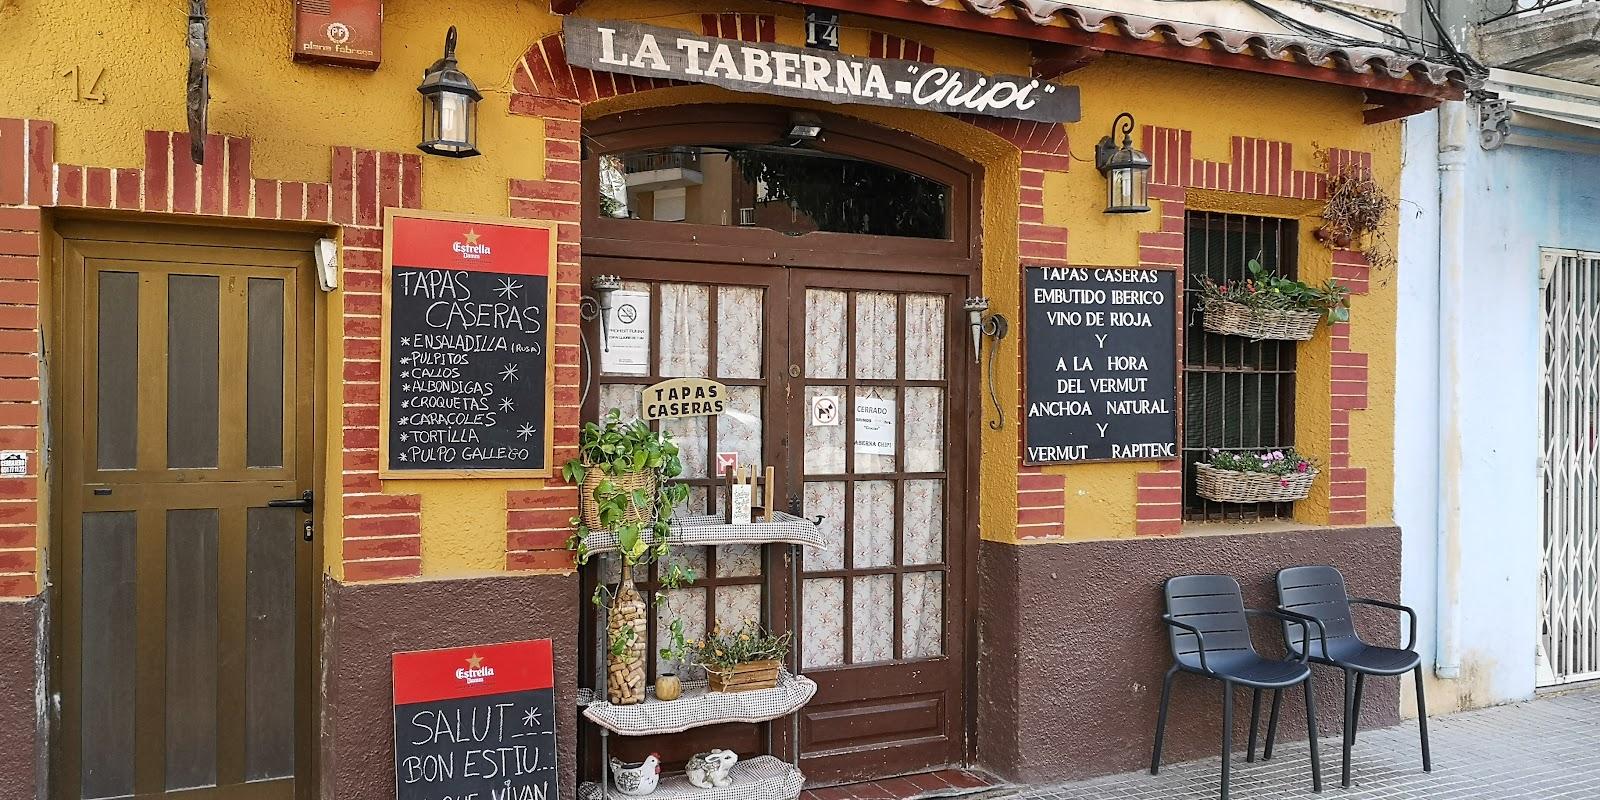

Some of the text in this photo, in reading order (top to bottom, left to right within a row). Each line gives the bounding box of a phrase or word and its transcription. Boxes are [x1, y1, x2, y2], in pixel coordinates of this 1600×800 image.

[807, 12, 838, 48] 14
[597, 27, 671, 71] LA
[62, 64, 107, 105] 14
[452, 240, 491, 255] Estrella
[1040, 266, 1158, 283] TAPAS CASERAS
[398, 269, 471, 301] TAPAS
[1034, 288, 1164, 305] EMBUTIDO IBERICO
[425, 301, 541, 333] CASERAS
[1046, 311, 1152, 327] VINO DE RIOJA
[413, 333, 508, 352] ENSALADILLA
[1095, 334, 1108, 349] Y
[411, 351, 469, 367] PULPITOS
[1055, 356, 1148, 372] A LA HORA
[411, 368, 461, 379] CALLOS
[412, 380, 494, 397] ALBONDIGAS
[655, 385, 718, 401] TAPAS
[1057, 377, 1148, 394] DEL VERMUT
[410, 396, 490, 411] CROQUETAS
[647, 400, 723, 418] CASERAS
[856, 405, 888, 415] CERRADO
[1028, 399, 1169, 417] ANCHOA NATURAL
[409, 412, 497, 427] CARACOLES
[409, 427, 480, 443] TORTILLA
[1096, 422, 1109, 438] Y
[407, 446, 529, 463] PULPO GALLEGO
[1028, 442, 1175, 462] VERMUT RAPITENC
[456, 666, 495, 680] Estrella
[402, 752, 454, 783] BON
